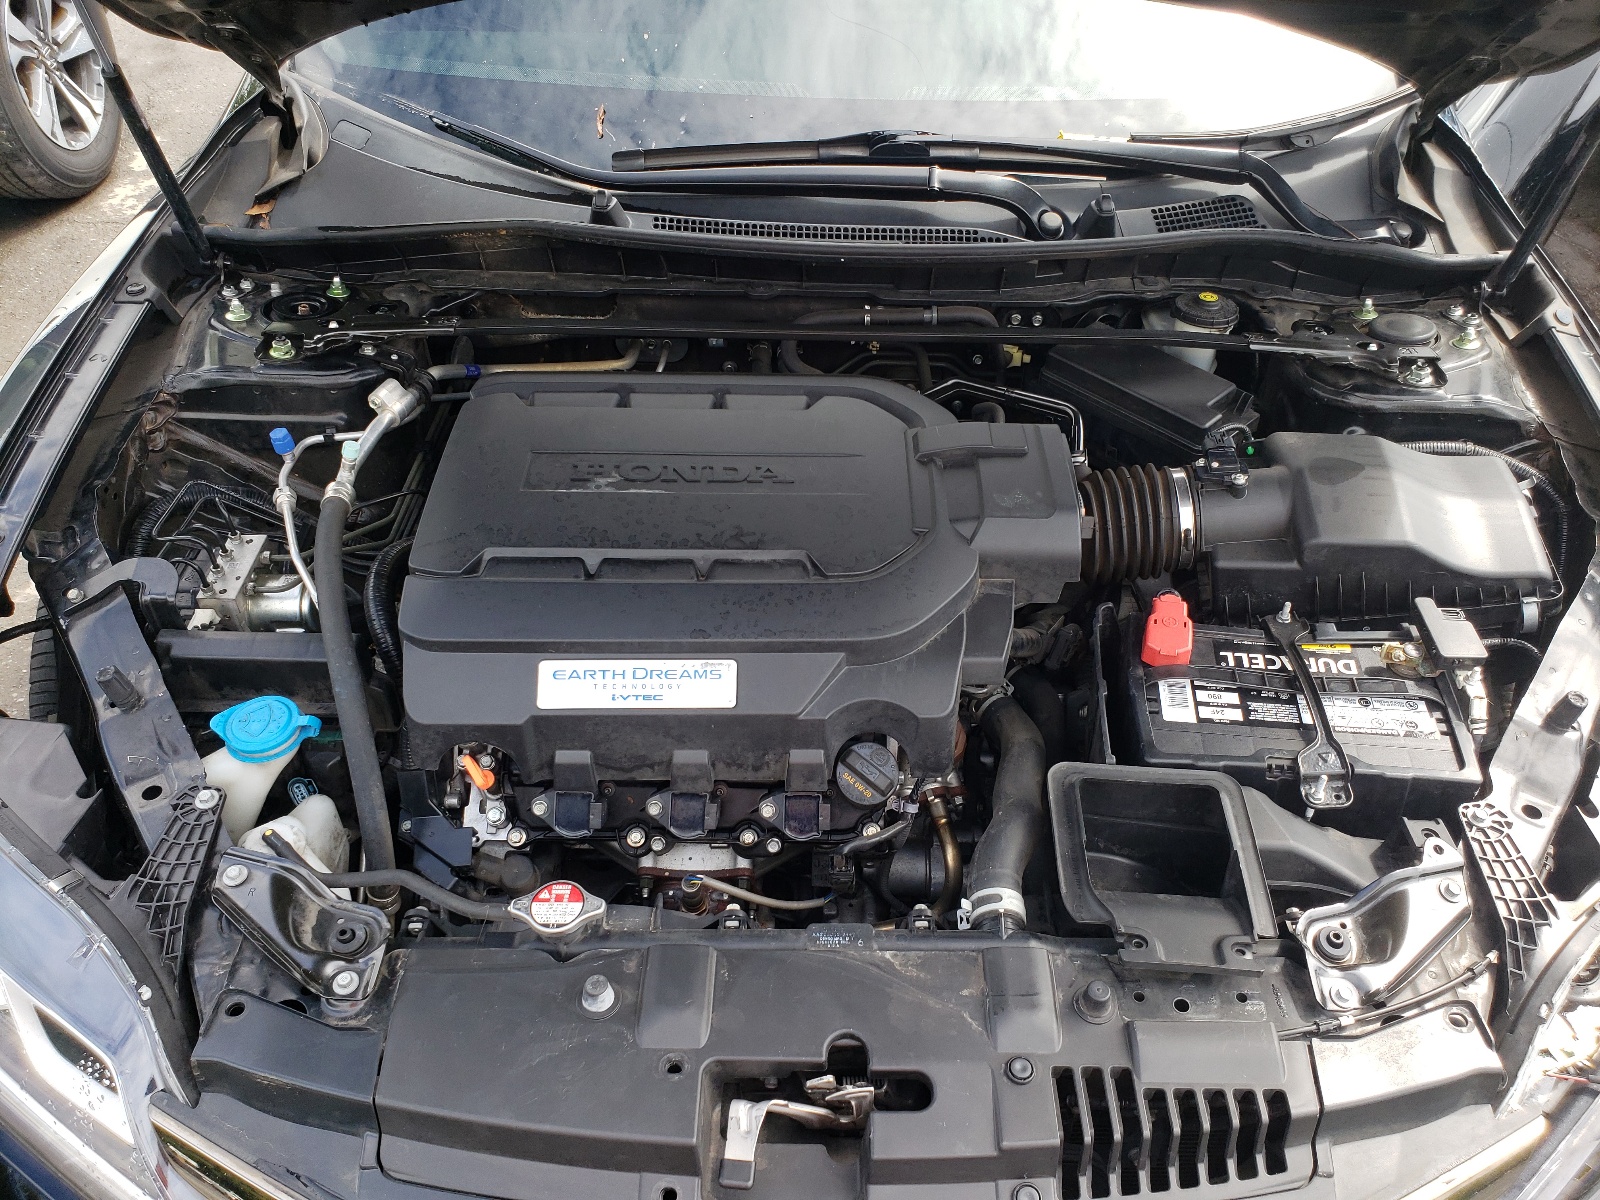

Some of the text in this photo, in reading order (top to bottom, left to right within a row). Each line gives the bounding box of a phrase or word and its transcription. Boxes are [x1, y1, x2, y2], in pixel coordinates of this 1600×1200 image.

[569, 463, 795, 484] HONDA
[552, 667, 722, 681] EARTH DREAMS
[842, 772, 856, 785] SAE
